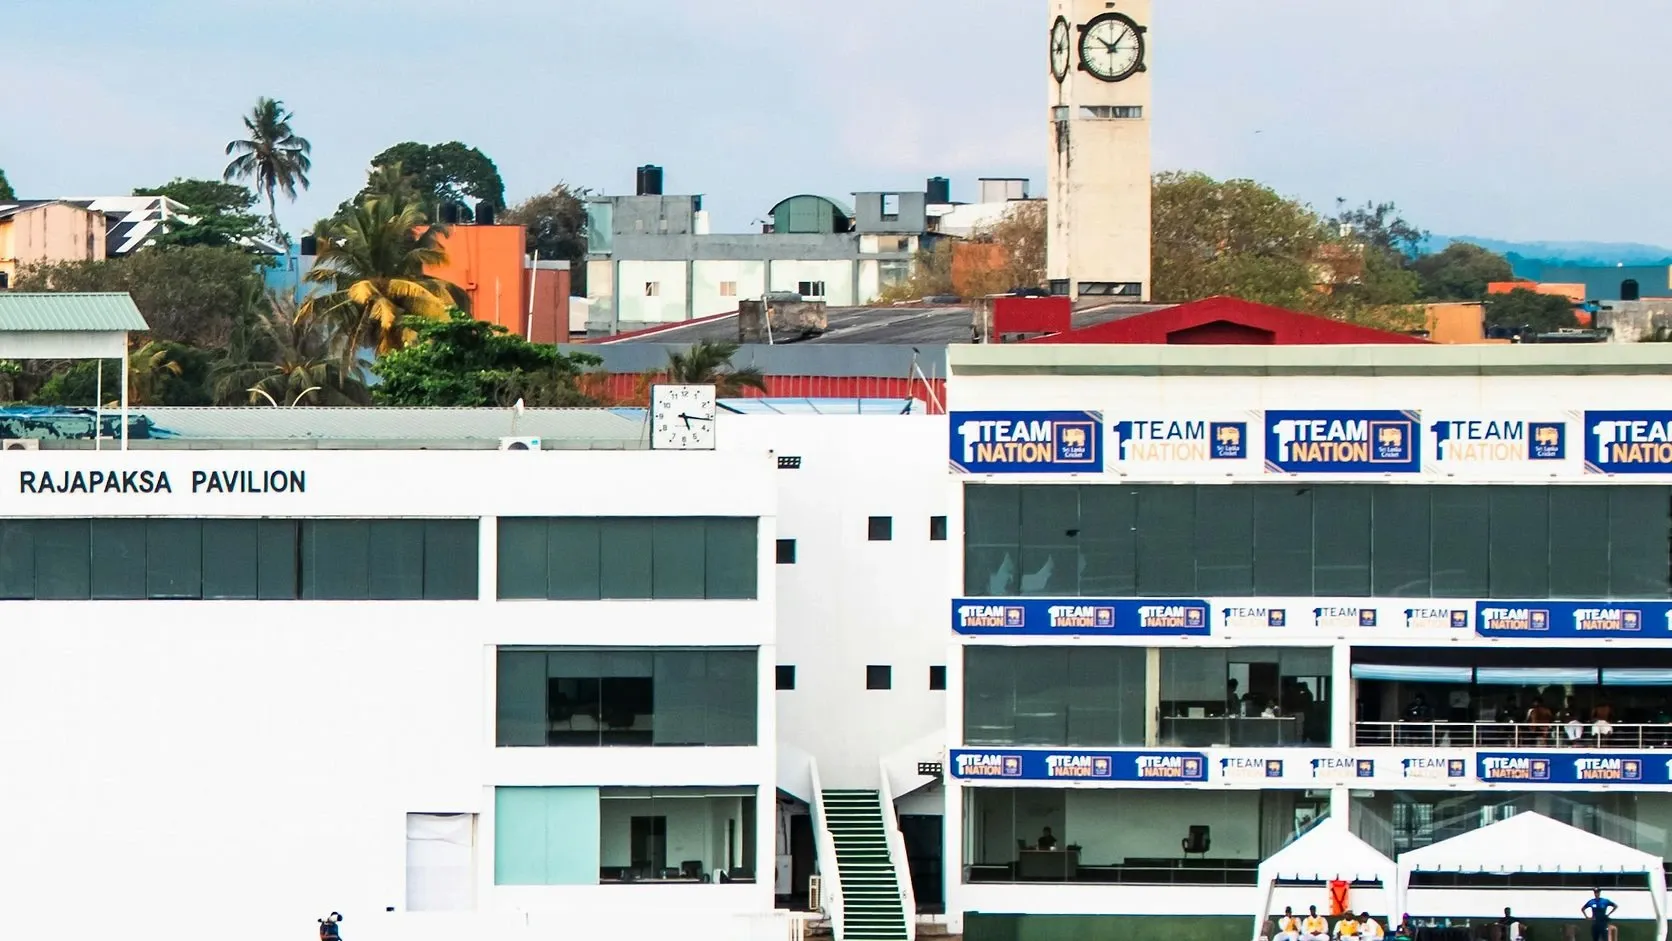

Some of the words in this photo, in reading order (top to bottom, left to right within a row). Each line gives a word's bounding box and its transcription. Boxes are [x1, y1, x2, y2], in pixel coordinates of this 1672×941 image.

[1615, 421, 1672, 442] TEA
[977, 443, 1052, 463] NATION
[1132, 444, 1204, 460] NATION
[1292, 442, 1368, 462] NATION
[1450, 443, 1523, 460] NATION
[20, 470, 172, 493] RAJAPAKSA
[192, 470, 306, 493] PAVILION
